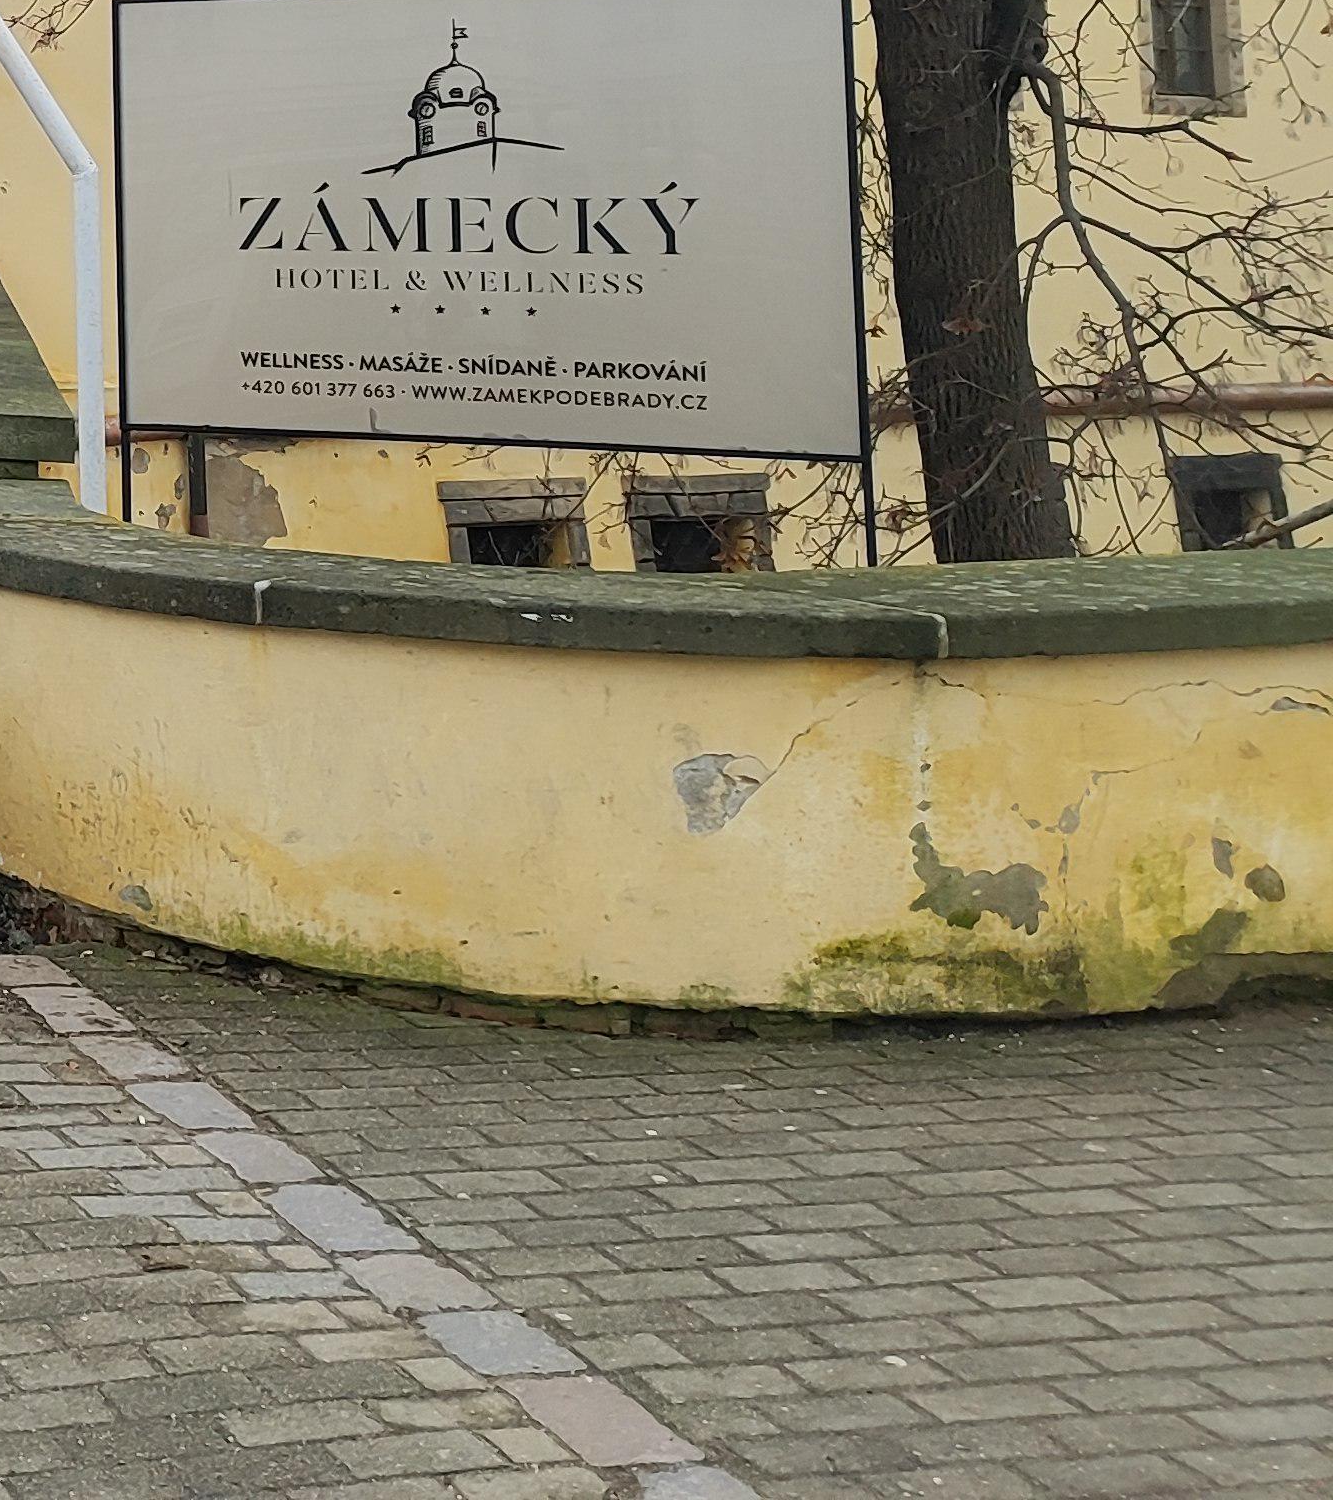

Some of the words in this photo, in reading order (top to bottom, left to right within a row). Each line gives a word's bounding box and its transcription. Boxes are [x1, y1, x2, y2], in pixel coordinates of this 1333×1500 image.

[238, 181, 700, 255] ZÁMECKÝ
[275, 268, 390, 291] HOTEL
[405, 269, 428, 291] &
[442, 270, 645, 295] WELLNESS
[240, 351, 344, 370] WELLNESS
[359, 352, 443, 374] MASÁŽE
[458, 354, 558, 377] SNÍDANĚ
[574, 359, 708, 383] PARKOVÁNÍ
[241, 380, 285, 395] +420
[291, 381, 321, 396] 601
[326, 382, 358, 397] 377
[363, 383, 396, 399] 663
[411, 384, 708, 411] WWW.ZAMEKPODEBRADY.CZ
